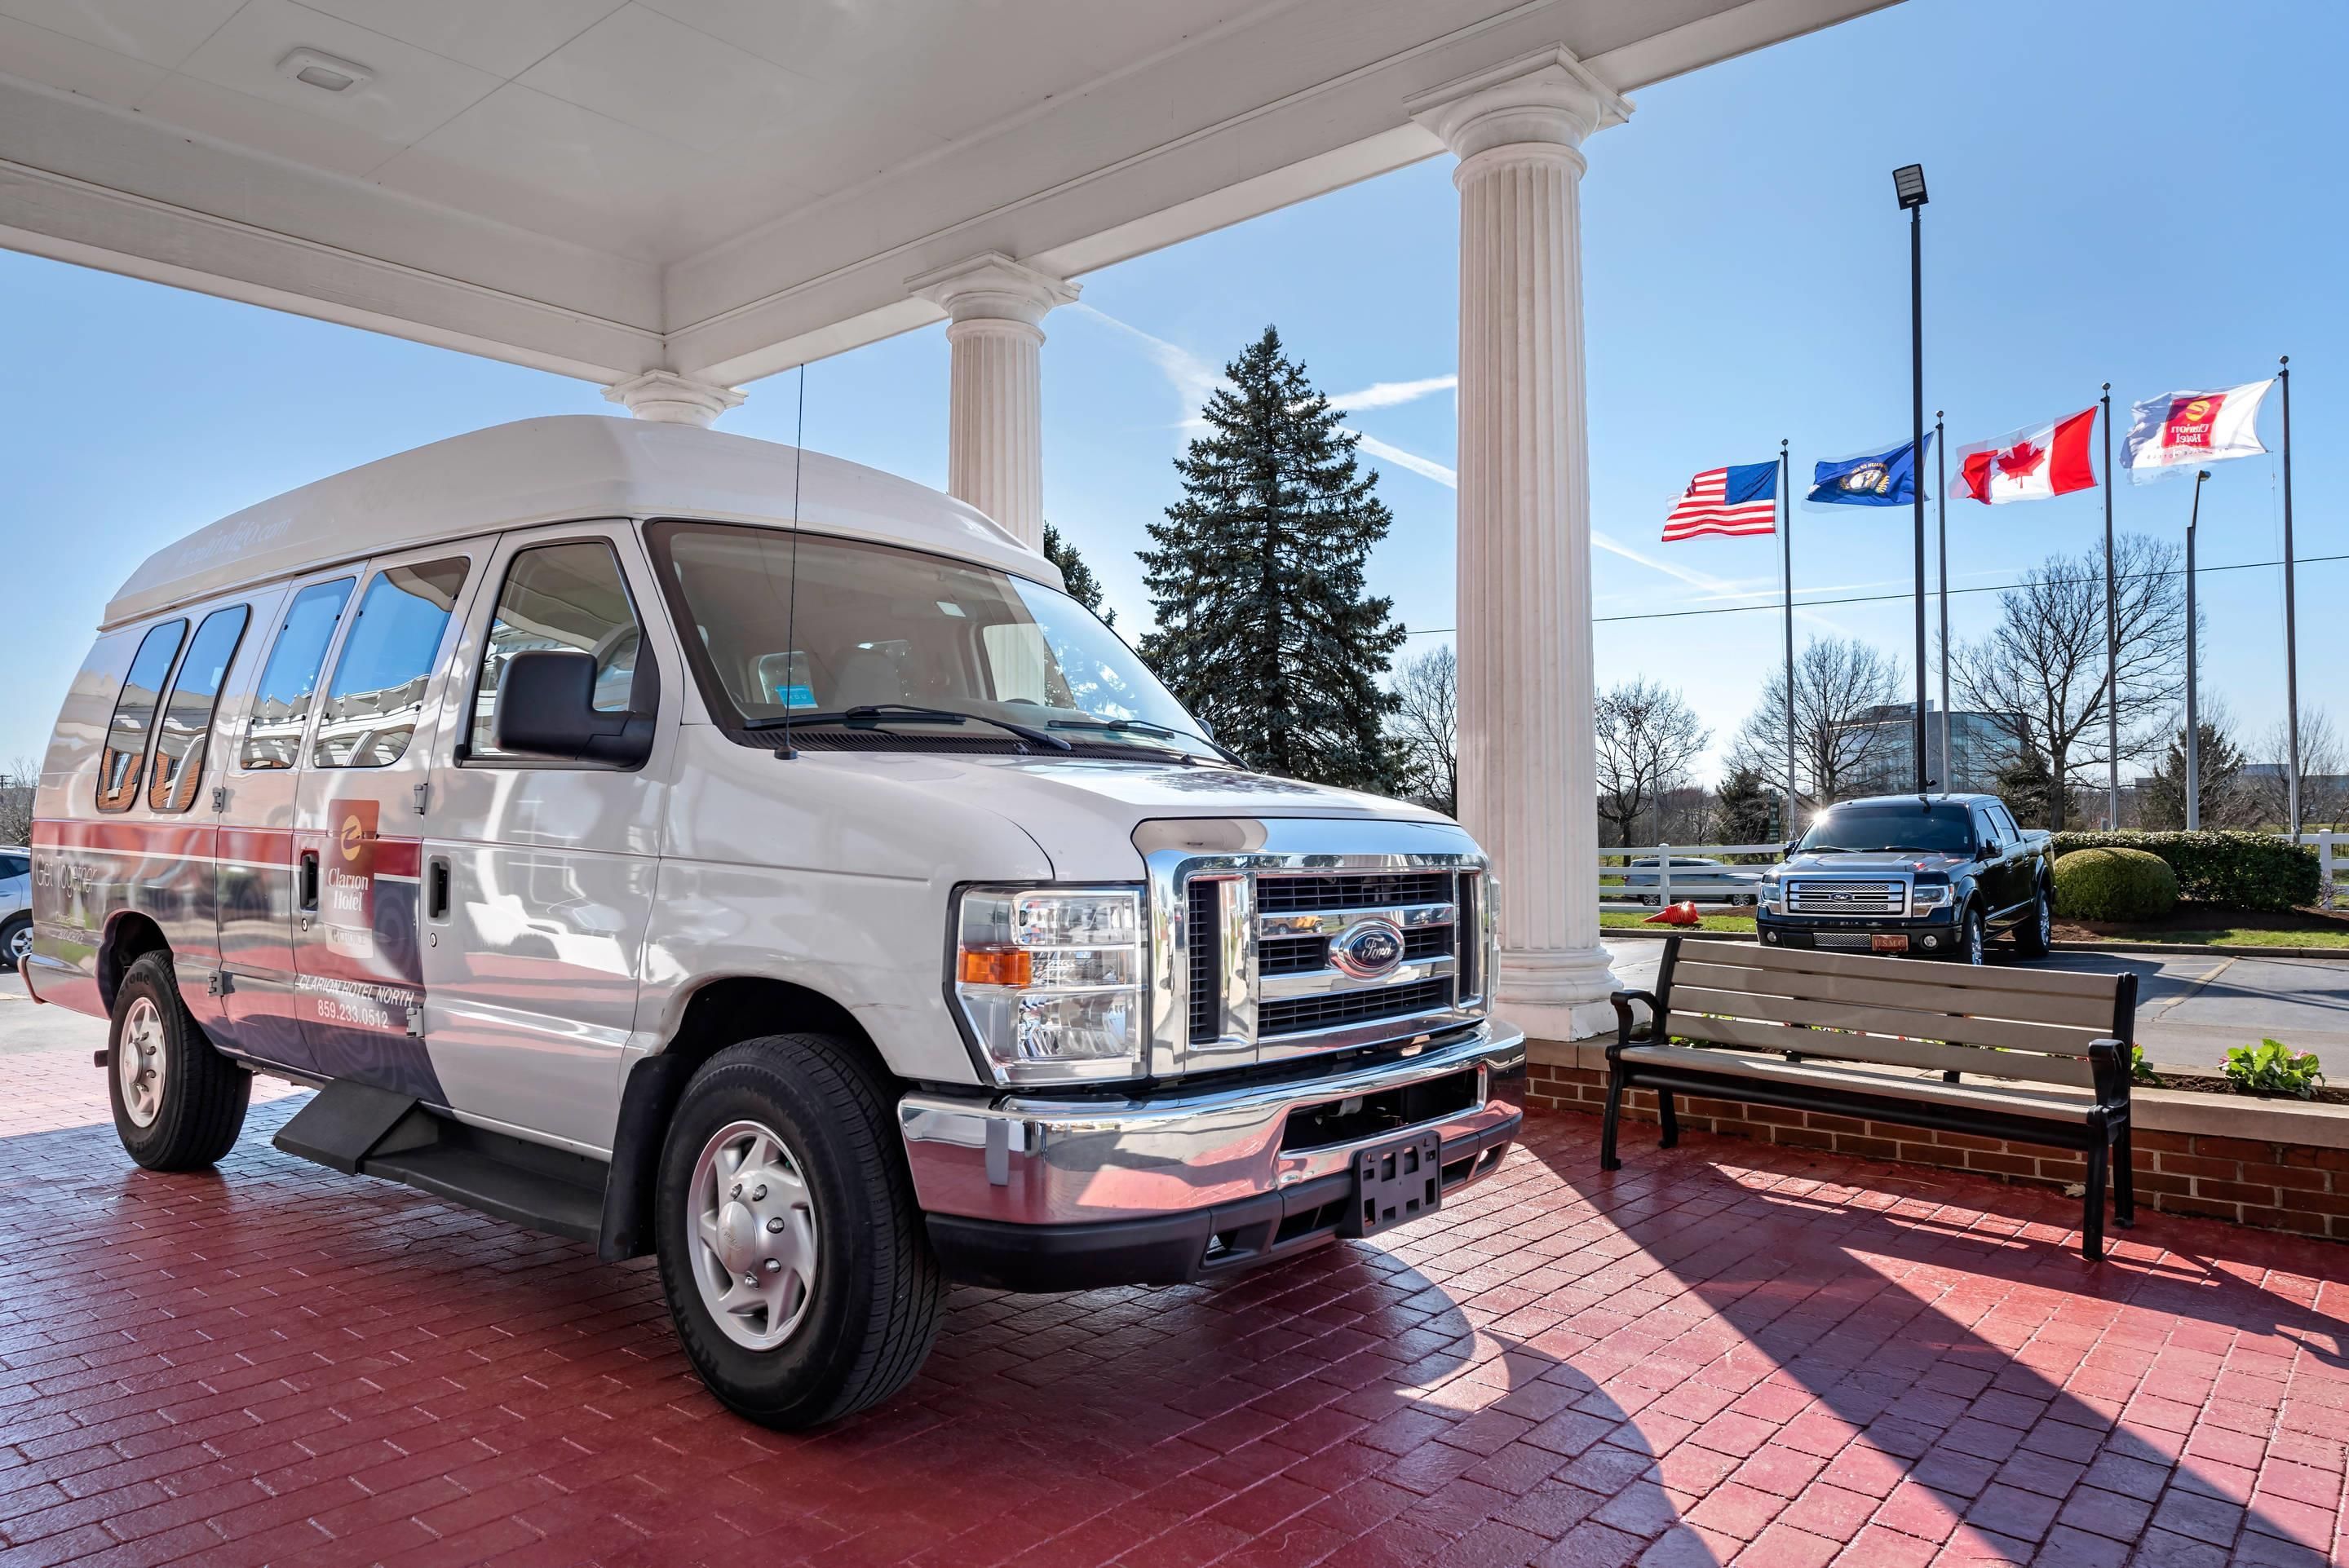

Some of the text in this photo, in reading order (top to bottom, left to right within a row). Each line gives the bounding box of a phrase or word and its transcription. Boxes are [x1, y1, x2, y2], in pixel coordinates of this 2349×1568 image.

[36, 854, 98, 898] Get Together
[328, 868, 369, 890] Clarion
[334, 890, 363, 912] Hotel
[1361, 937, 1394, 961] Ford
[299, 974, 414, 1007] CLARION HOTEL NORTH
[317, 999, 389, 1029] 859.233.0512
